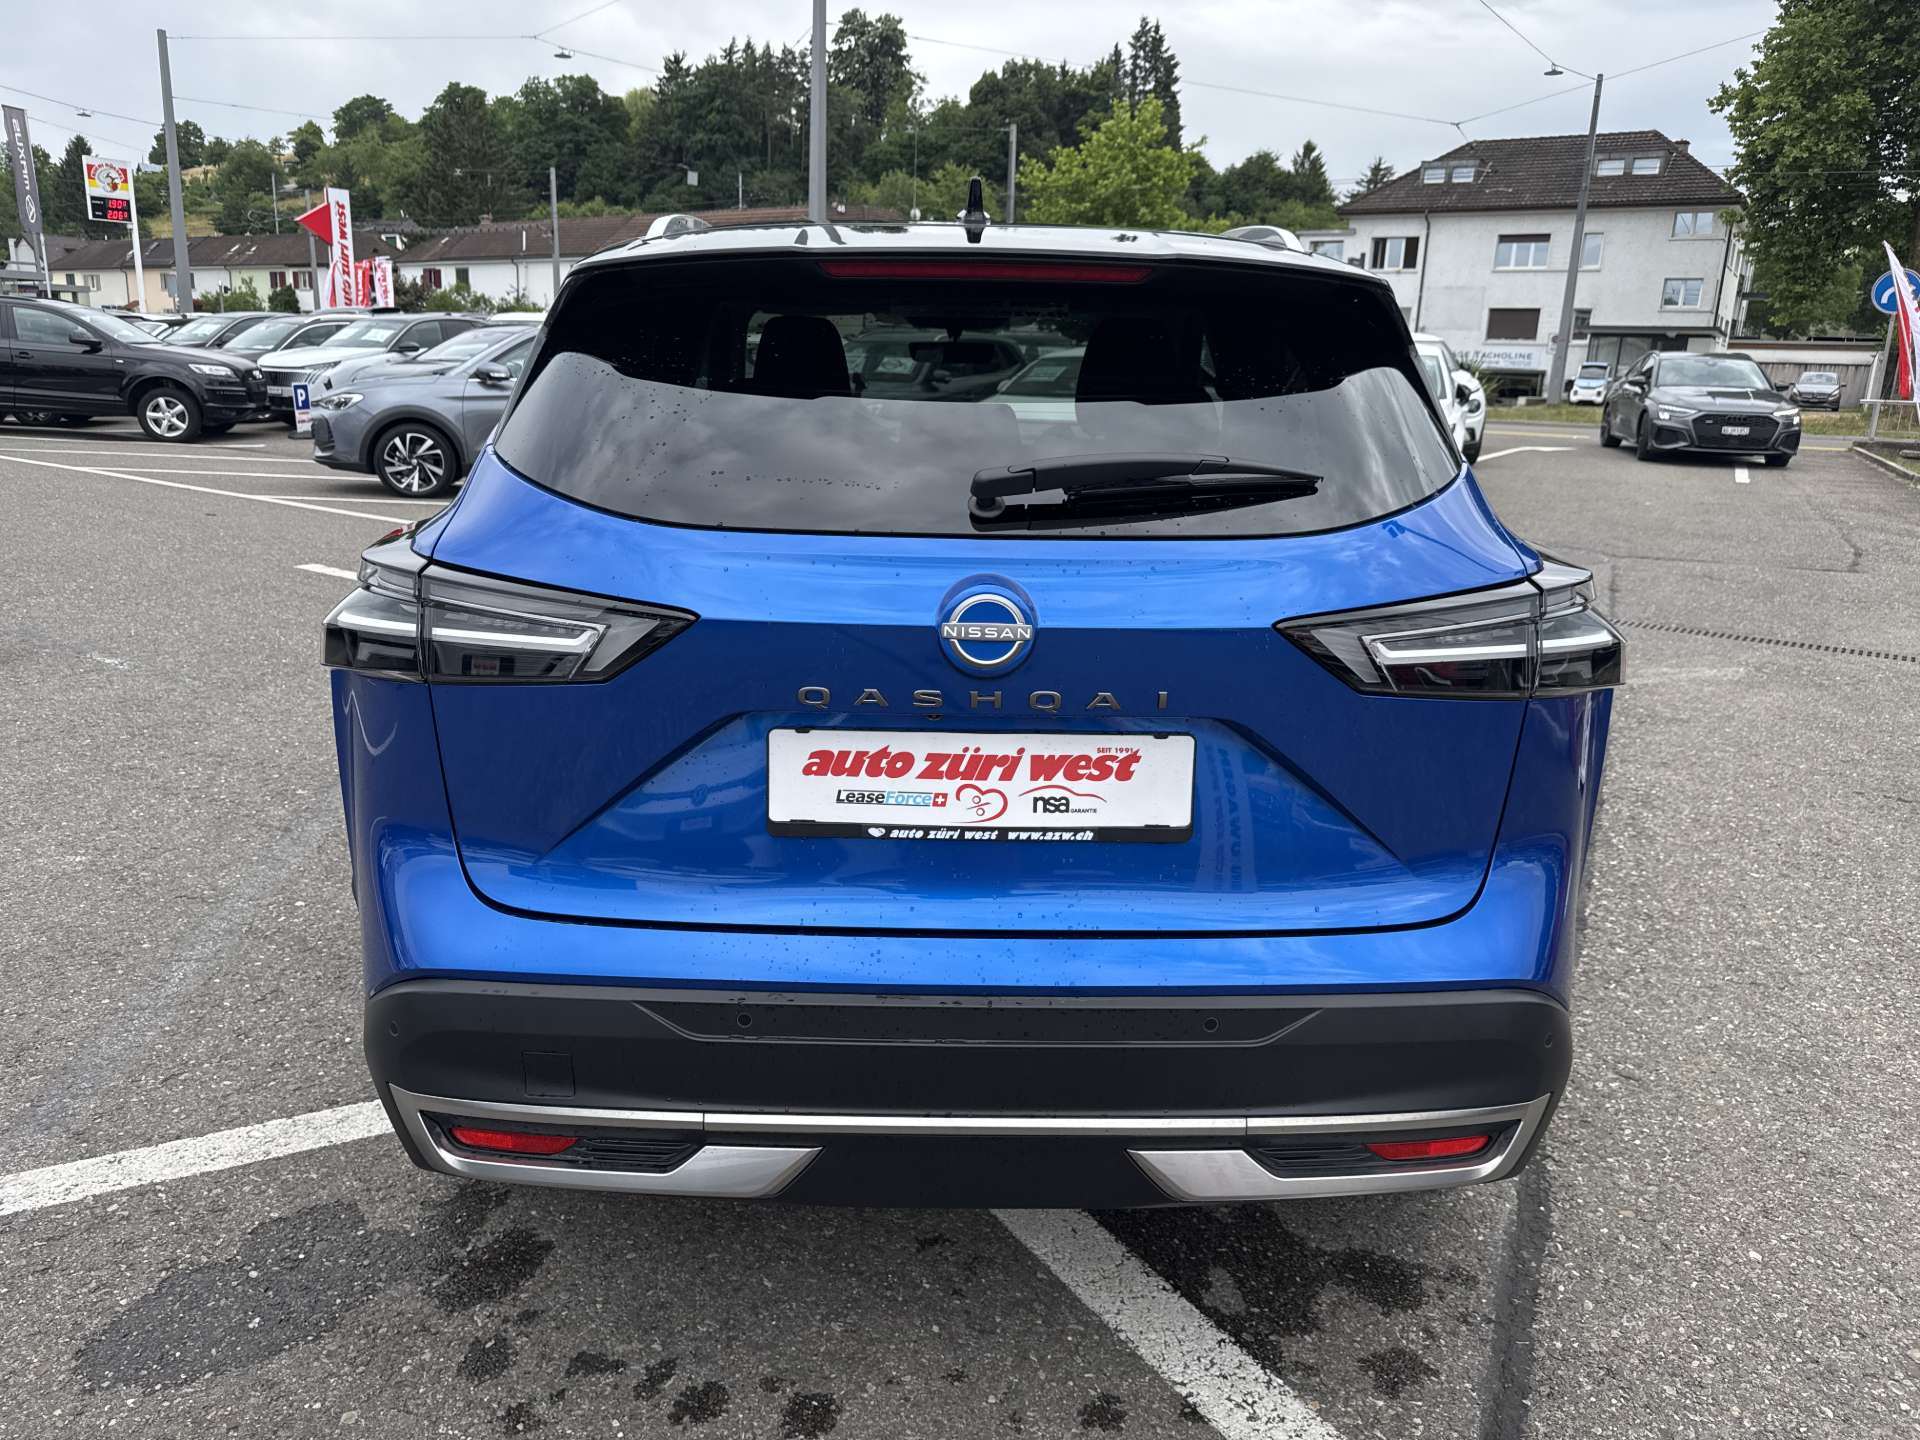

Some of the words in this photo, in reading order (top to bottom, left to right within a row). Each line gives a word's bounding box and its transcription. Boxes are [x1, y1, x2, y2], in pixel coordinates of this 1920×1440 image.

[296, 388, 306, 408] P
[943, 624, 1031, 640] NISSAN
[797, 686, 1169, 713] QASHQAI
[802, 745, 915, 779] auto
[915, 746, 1026, 781] züri
[1030, 748, 1142, 782] west
[835, 789, 933, 807] LeaseForce
[1032, 796, 1070, 814] nsa
[889, 828, 924, 839] auto
[964, 830, 998, 840] west
[1008, 830, 1094, 841] www.azw.ch
